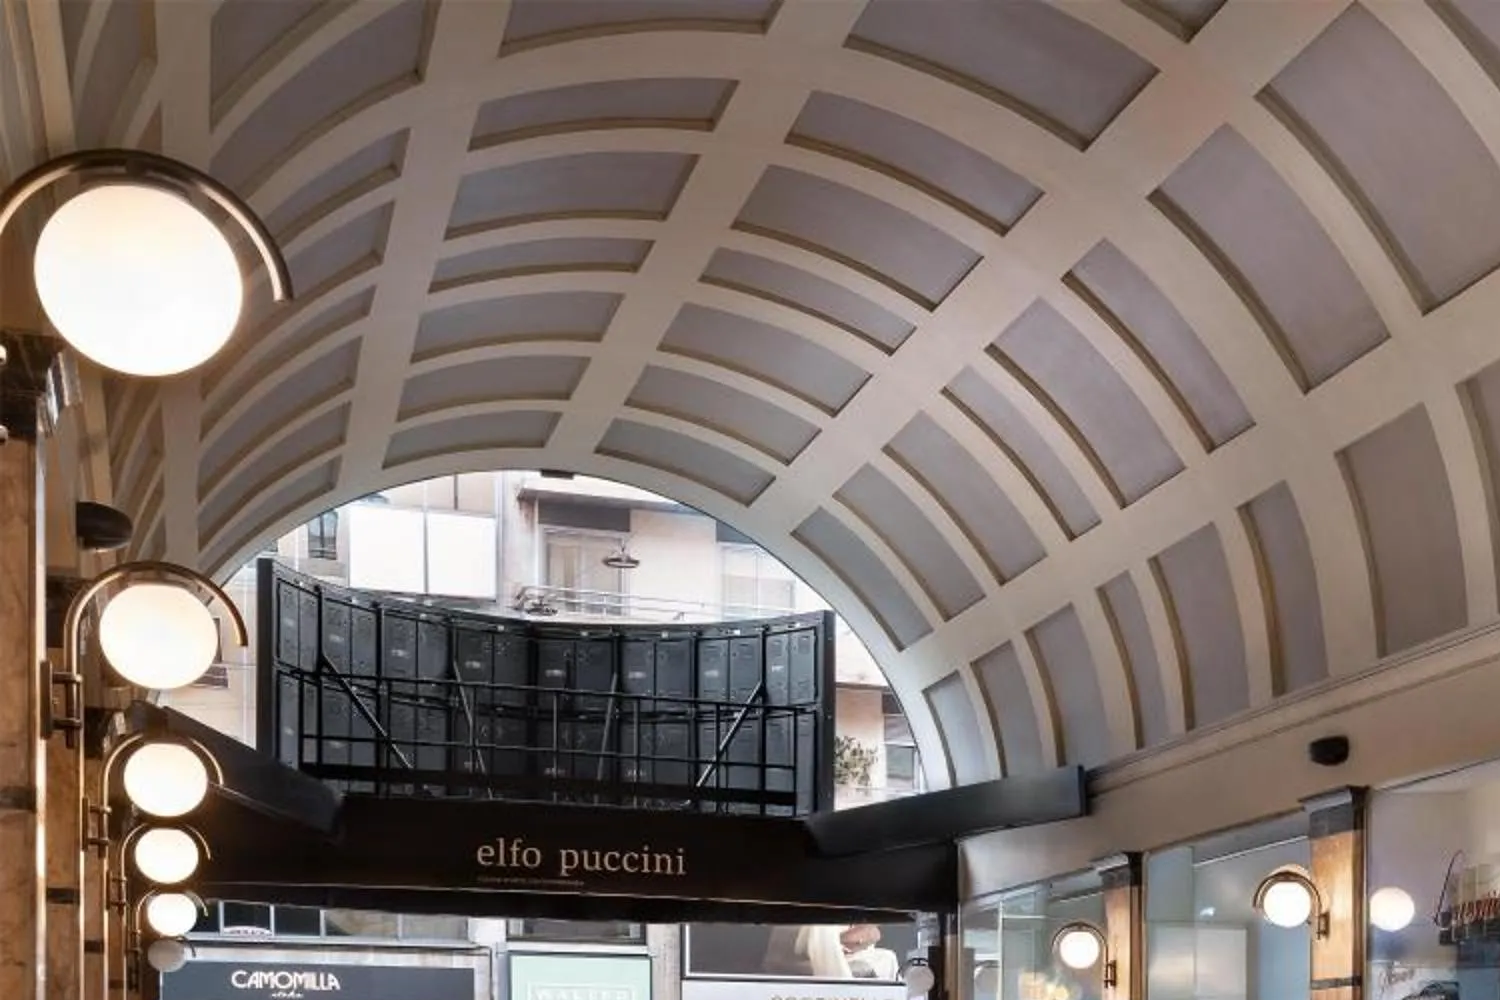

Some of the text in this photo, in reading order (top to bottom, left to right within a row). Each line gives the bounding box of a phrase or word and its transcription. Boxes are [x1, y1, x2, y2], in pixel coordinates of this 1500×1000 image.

[476, 837, 688, 877] elfo puccini
[231, 969, 341, 990] CAMOMILLA
